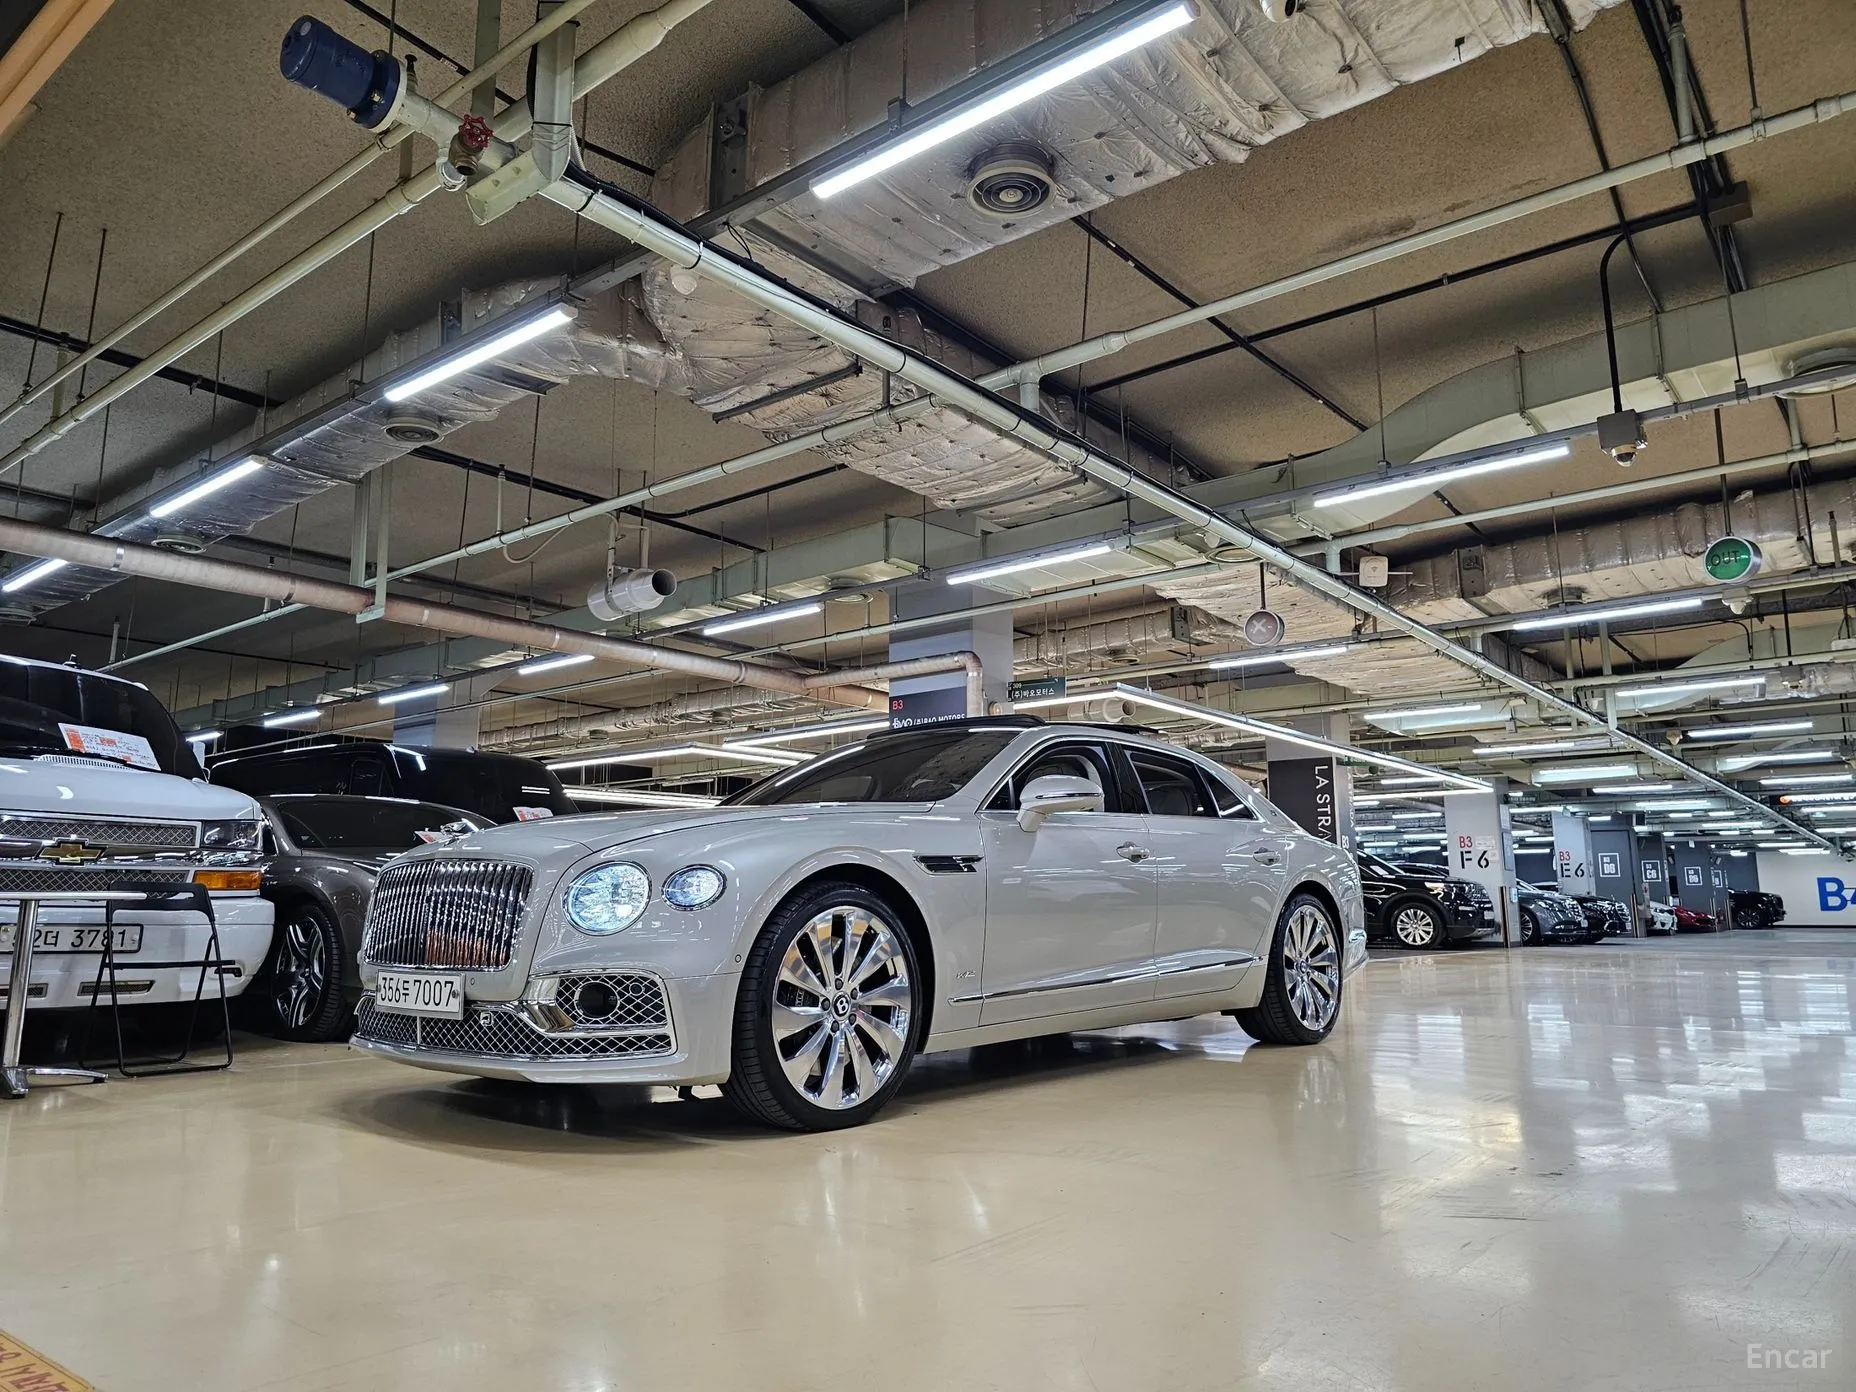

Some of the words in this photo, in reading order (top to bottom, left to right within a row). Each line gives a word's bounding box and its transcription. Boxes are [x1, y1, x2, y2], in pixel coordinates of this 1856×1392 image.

[1711, 550, 1740, 567] OUT
[892, 700, 904, 710] B3
[1314, 765, 1329, 789] LA
[1459, 835, 1473, 848] B3
[1559, 851, 1571, 861] B3
[12, 929, 60, 948] 2더
[71, 929, 126, 948] 3781
